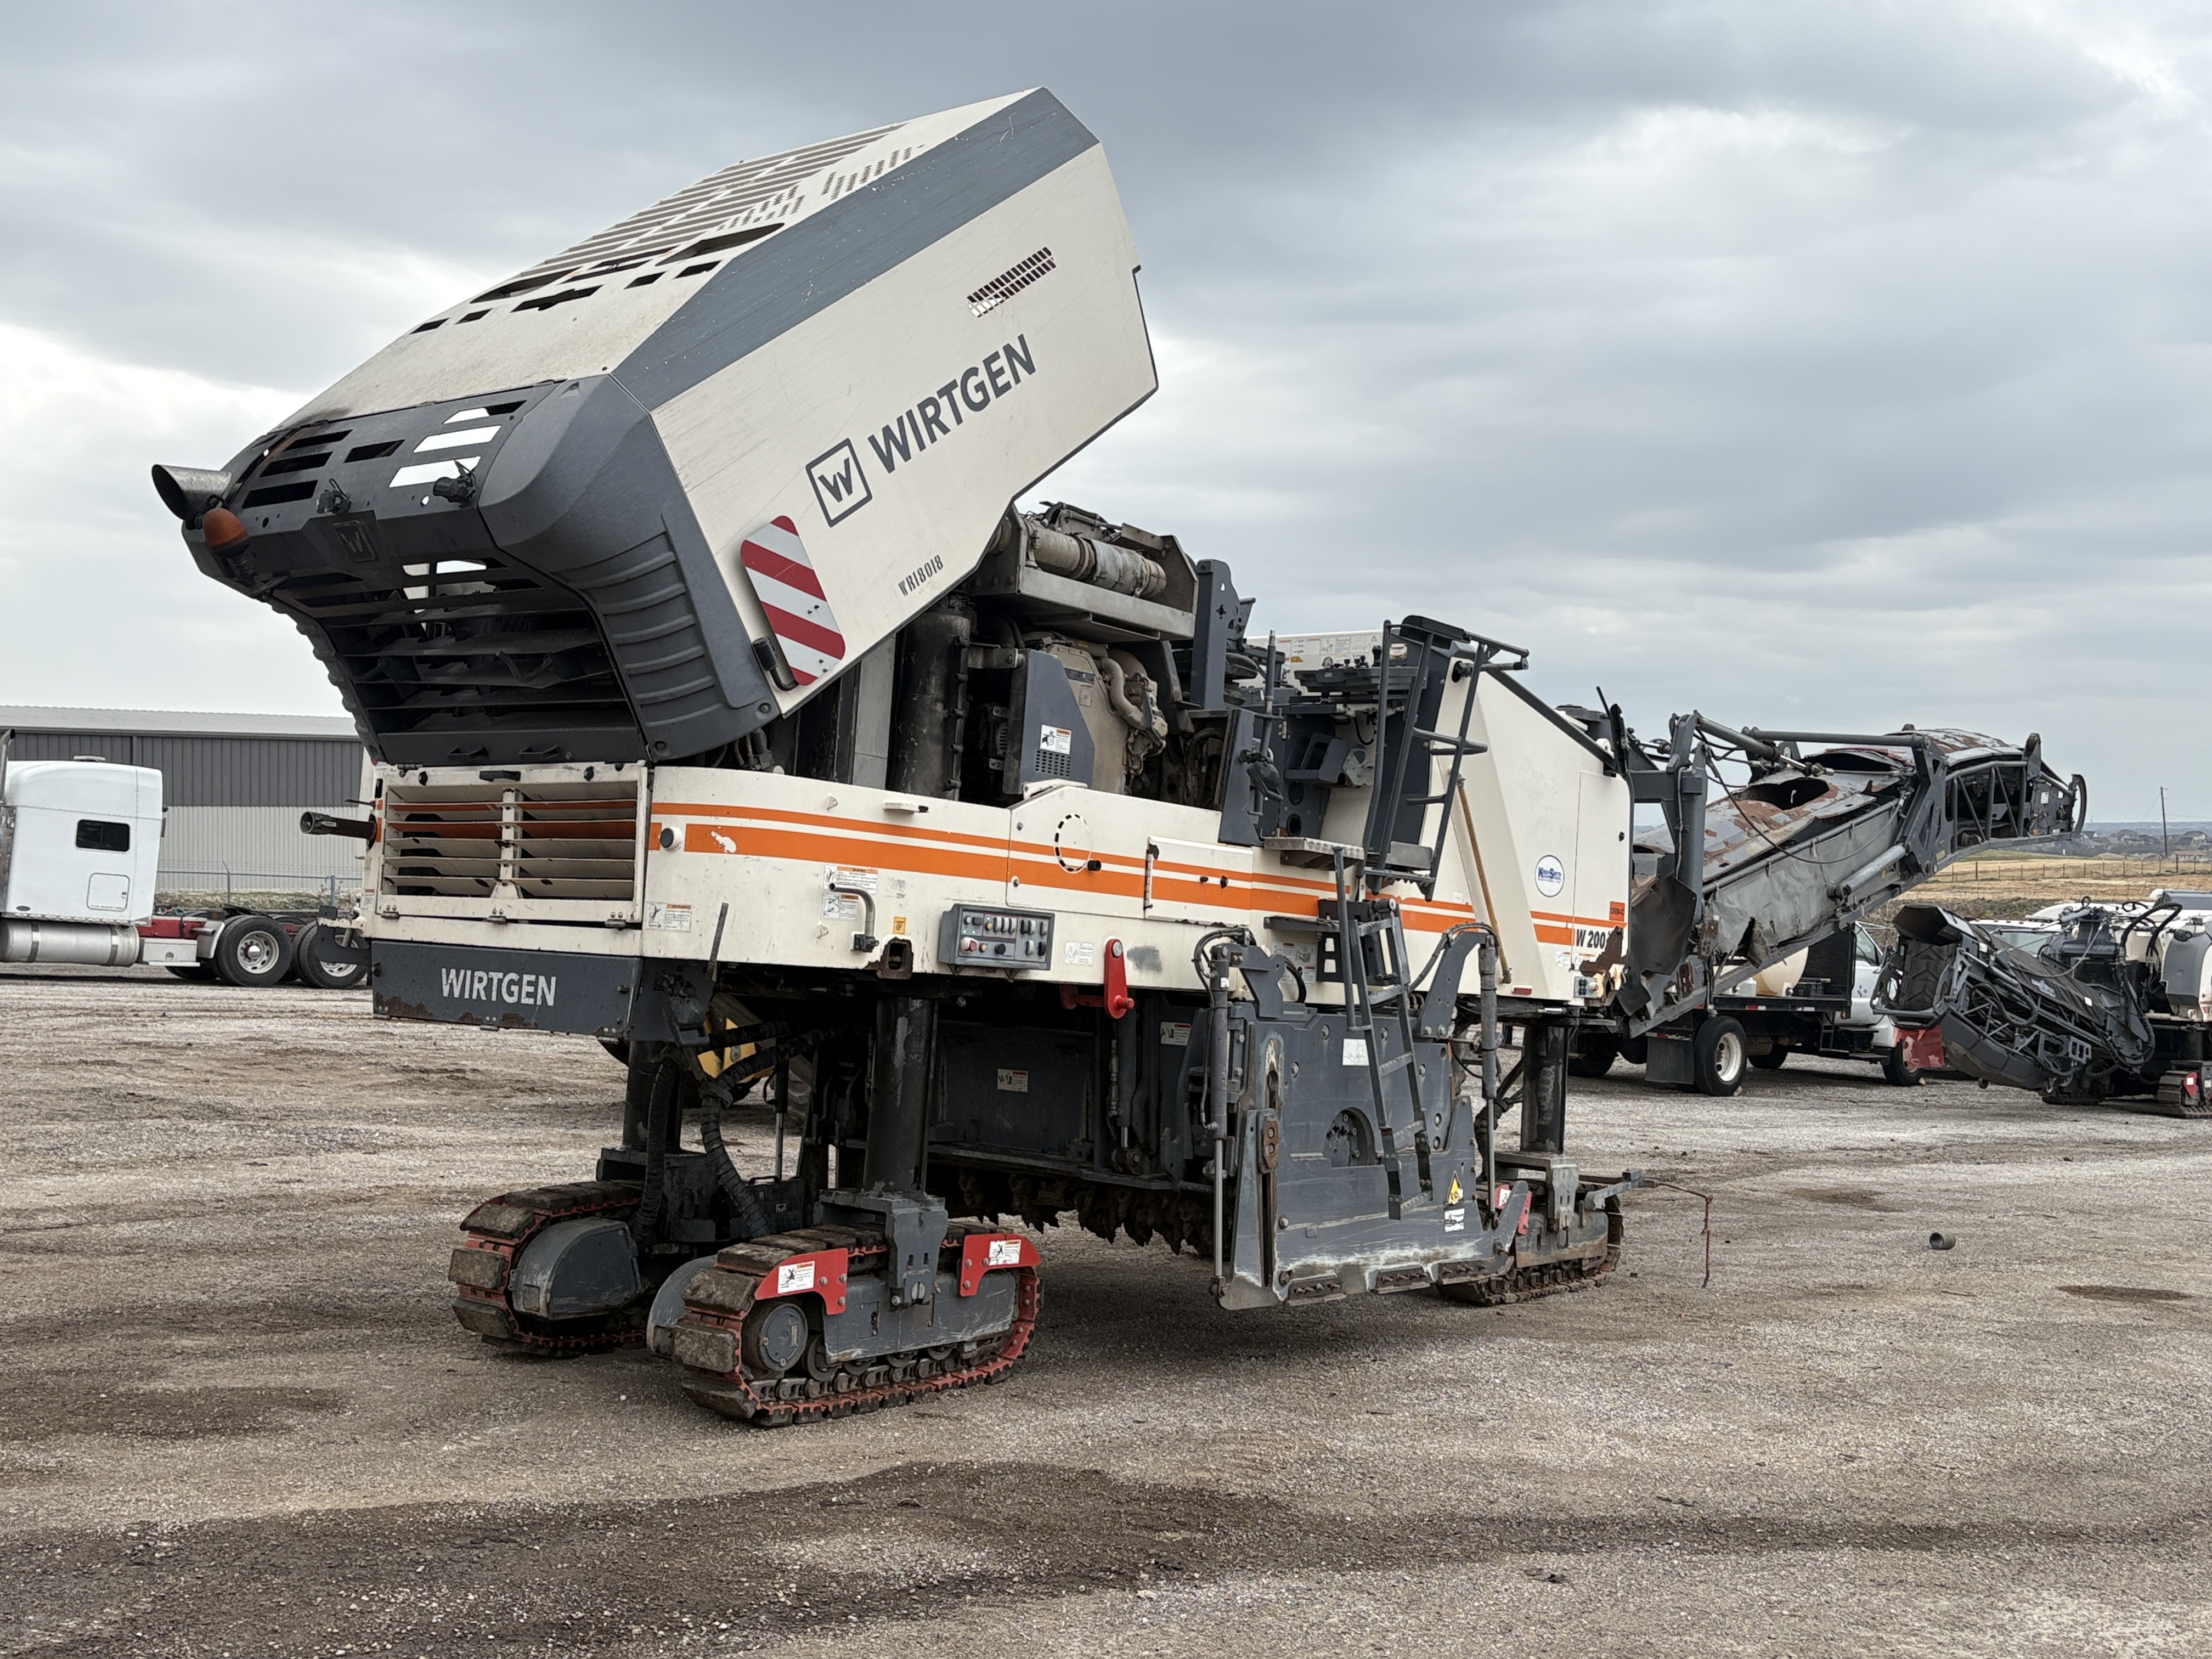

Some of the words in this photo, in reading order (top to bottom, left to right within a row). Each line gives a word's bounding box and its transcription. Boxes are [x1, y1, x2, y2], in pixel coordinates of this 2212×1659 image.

[867, 332, 1036, 475] WIRTGEN
[1576, 929, 1587, 947] W
[441, 967, 557, 1007] WIRTGEN
